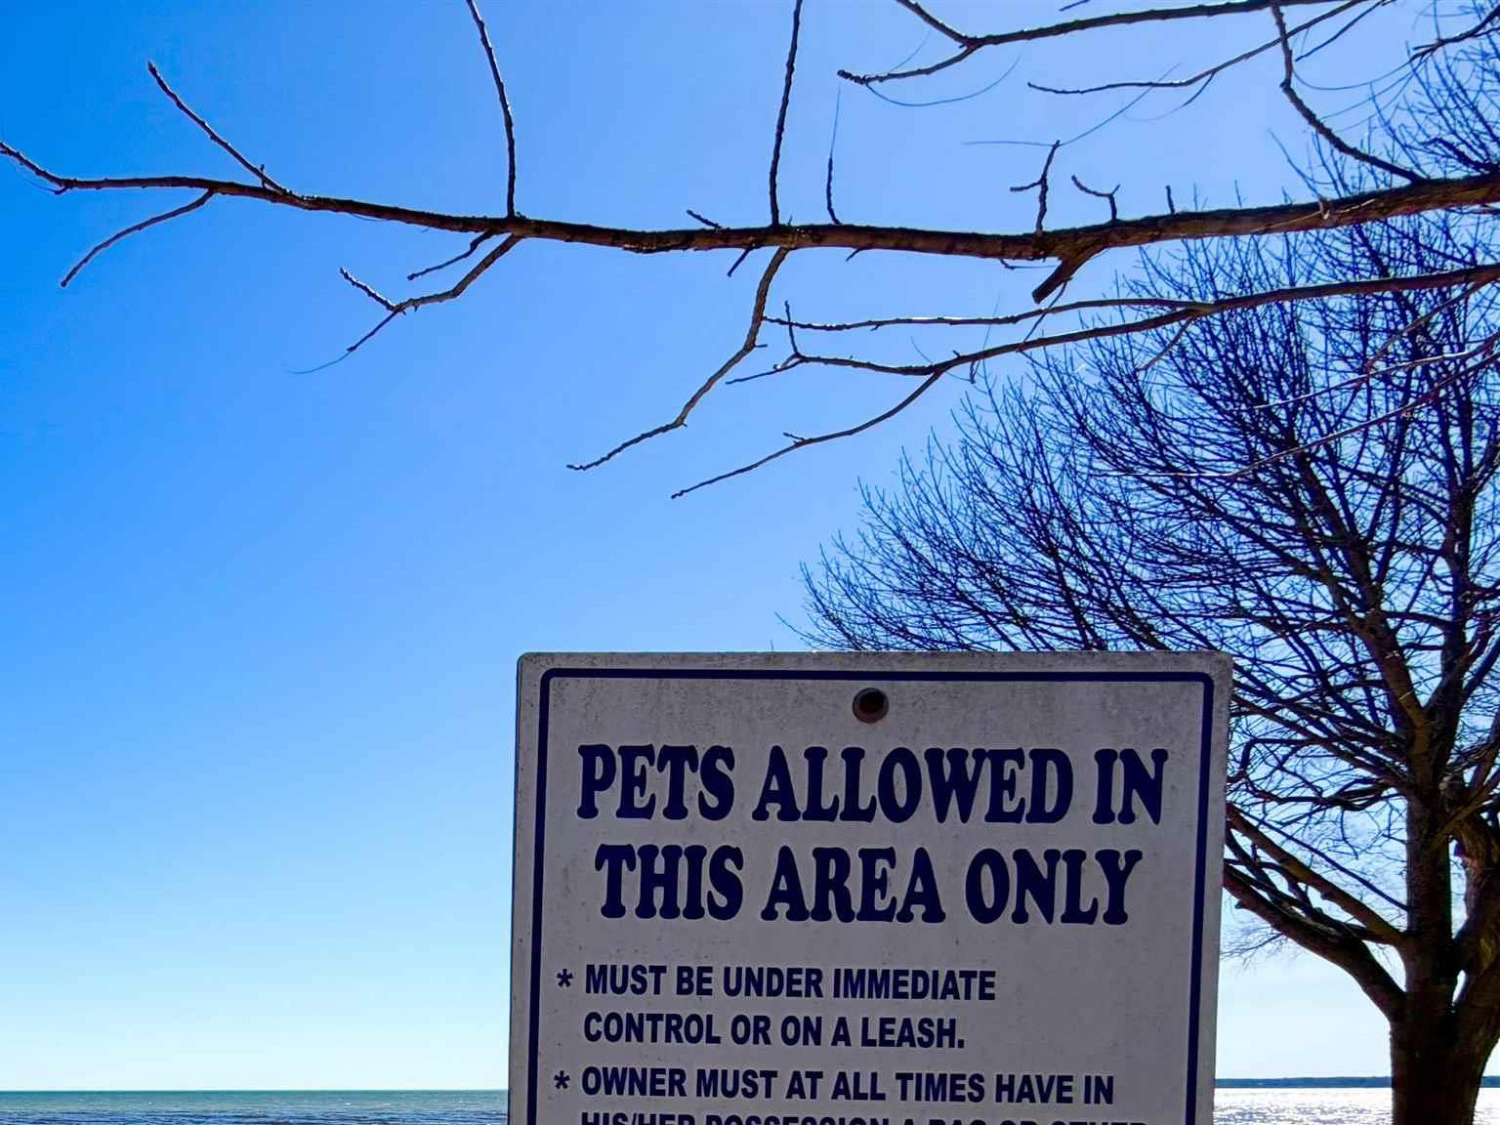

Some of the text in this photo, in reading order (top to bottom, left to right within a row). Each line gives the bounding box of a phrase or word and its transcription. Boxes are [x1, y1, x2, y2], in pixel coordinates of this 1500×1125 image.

[576, 743, 1169, 826] PETS ALLOWED IN
[594, 843, 1143, 926] THIS AREA ONLY
[585, 964, 997, 1001] MUST BE UNDER IMMEDIATE
[584, 1011, 965, 1049] CONTROL OR ON A LEASH.
[581, 1066, 1114, 1105] OWNER MUST AT ALL TIMES HAVE IN
